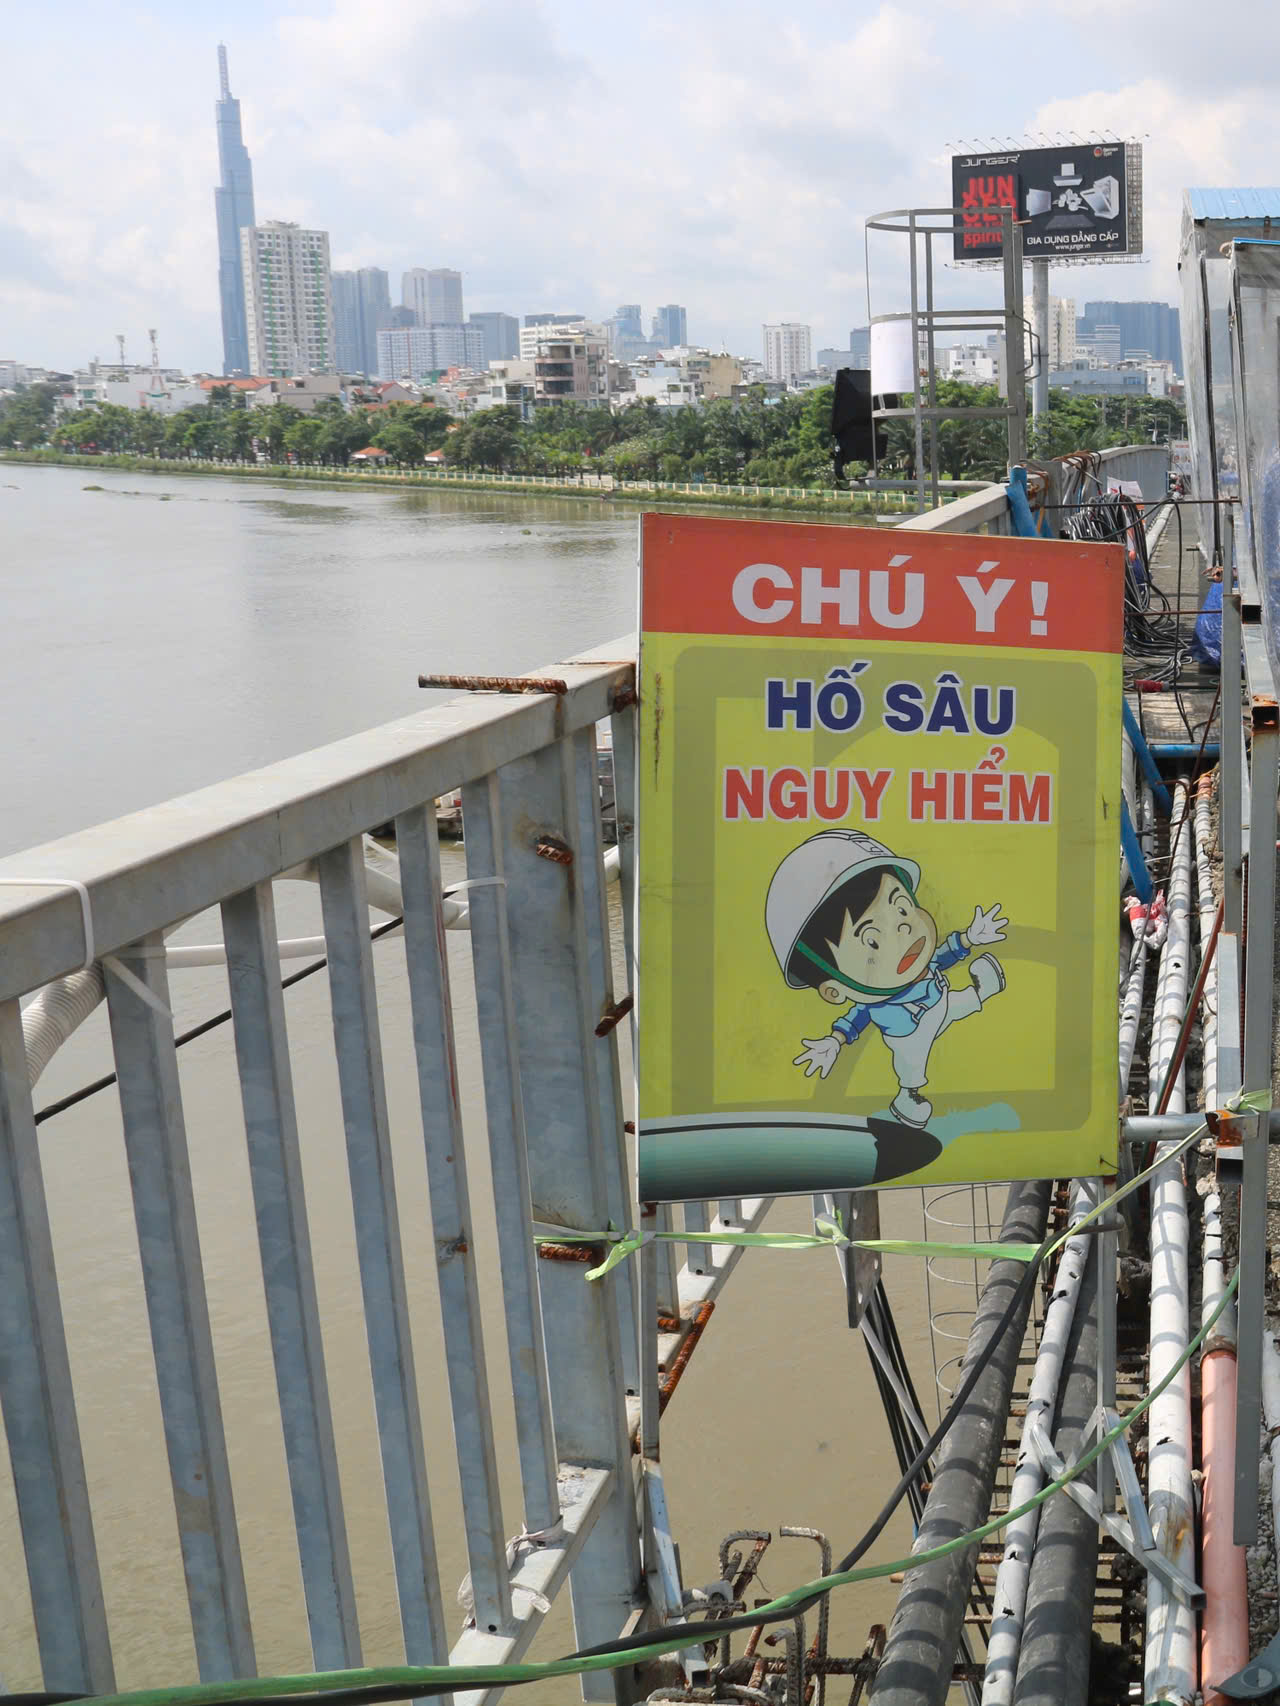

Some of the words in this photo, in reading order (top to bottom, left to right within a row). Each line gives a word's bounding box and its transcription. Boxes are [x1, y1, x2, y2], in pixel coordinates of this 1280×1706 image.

[962, 175, 1014, 200] JUN
[1027, 237, 1042, 245] GIA
[1044, 235, 1070, 246] DỤNG
[1071, 231, 1097, 243] ĐẲNG
[1099, 229, 1119, 242] CẤP
[732, 555, 925, 626] CHÚ
[765, 661, 872, 732] HỐ
[884, 672, 1015, 735] SÂU
[724, 767, 891, 821] NGUY
[910, 746, 1051, 824] HIỂM
